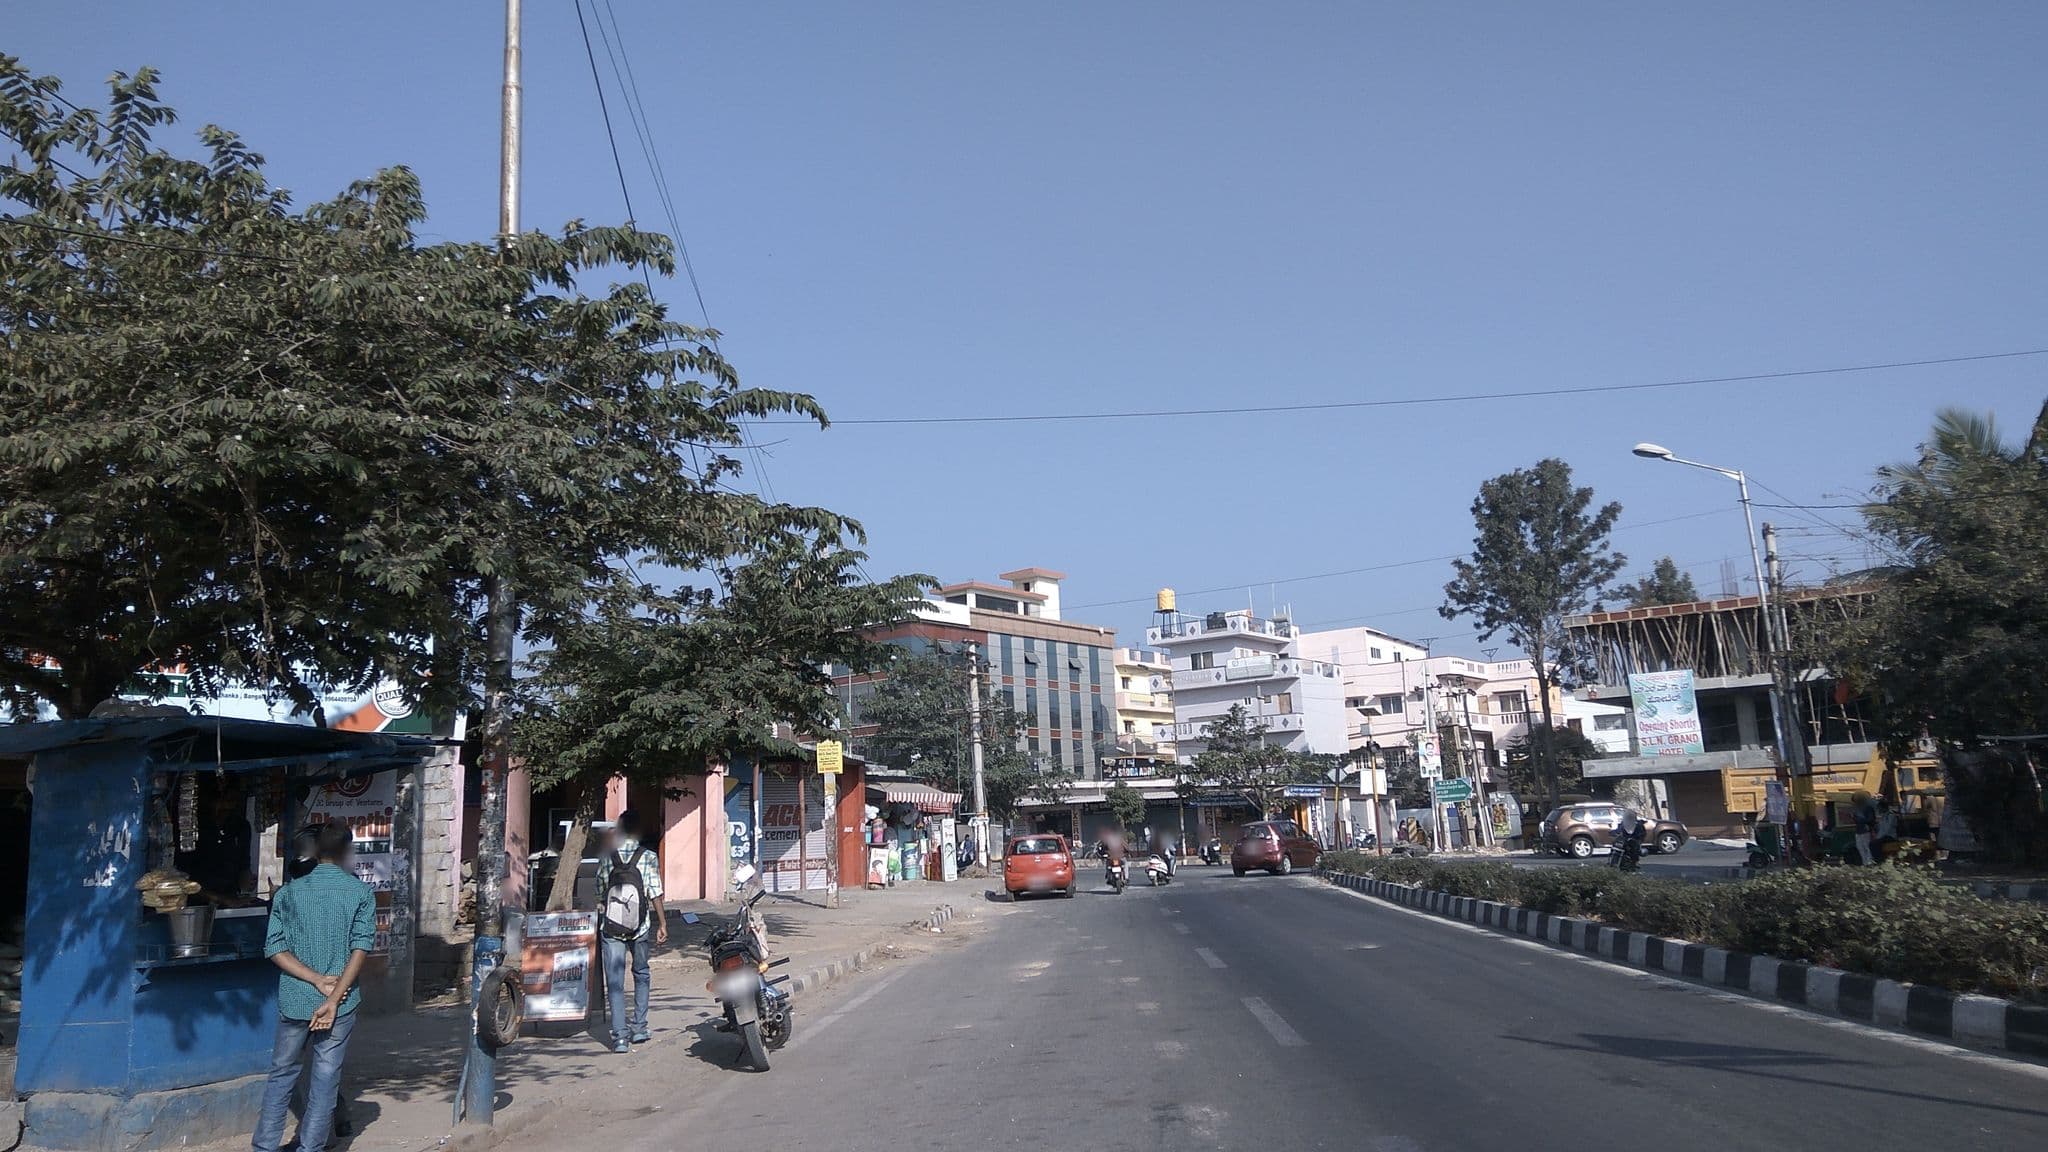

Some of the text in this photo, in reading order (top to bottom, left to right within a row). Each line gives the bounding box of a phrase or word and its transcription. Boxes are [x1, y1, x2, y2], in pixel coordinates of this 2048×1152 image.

[1639, 717, 1697, 734] Opening Shortly
[1667, 733, 1699, 745] GRAND
[765, 829, 801, 841] cemen
